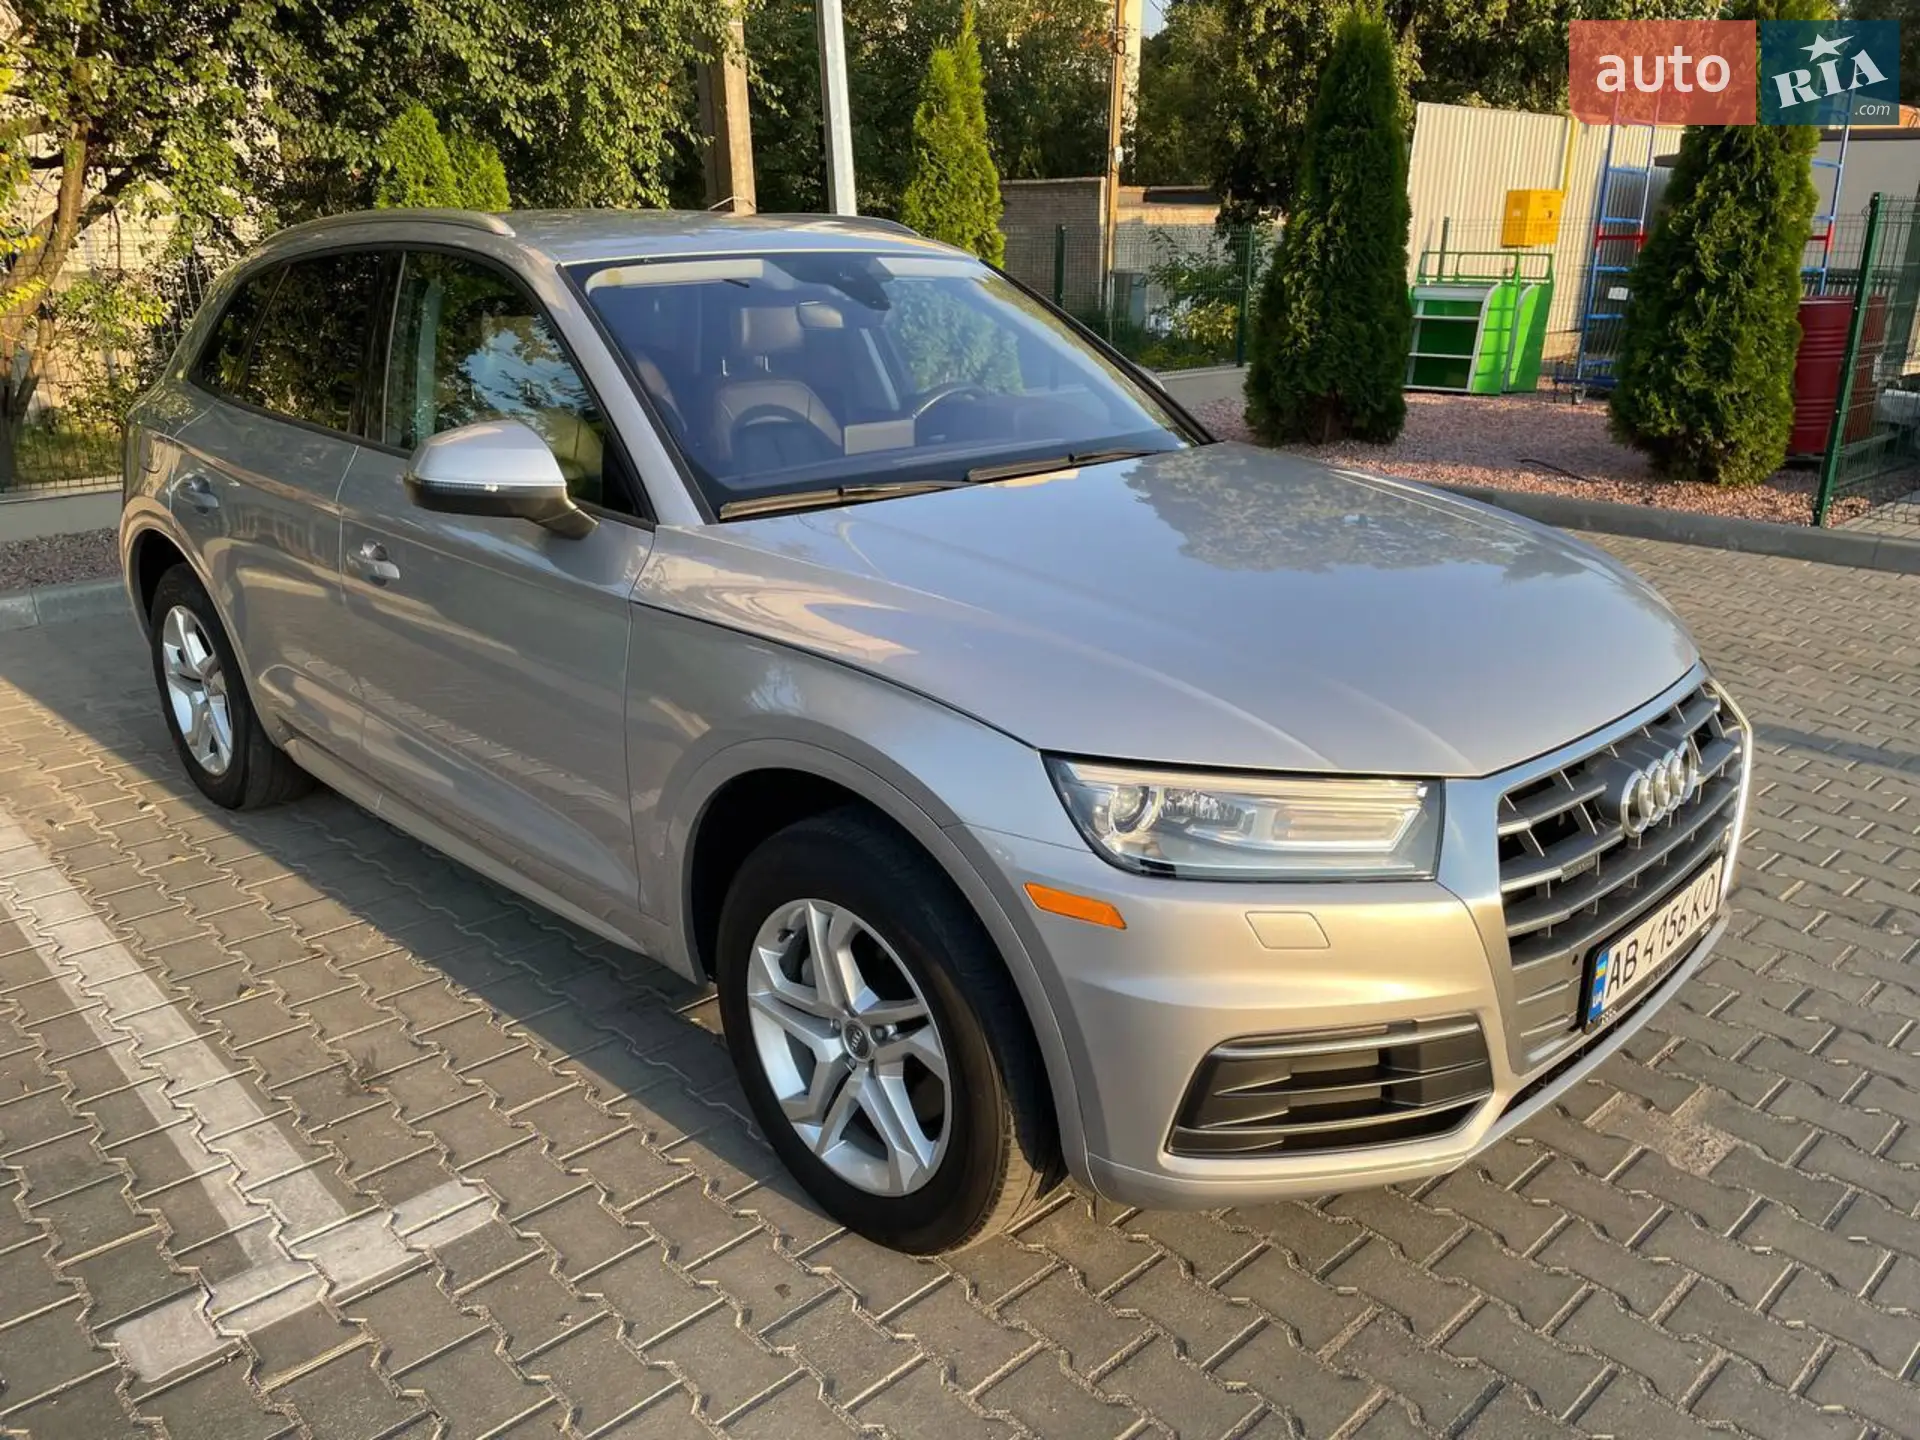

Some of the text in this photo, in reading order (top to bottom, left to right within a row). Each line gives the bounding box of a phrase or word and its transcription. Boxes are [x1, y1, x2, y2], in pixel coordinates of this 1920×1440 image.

[1606, 938, 1639, 999] AB
[1643, 894, 1689, 965] 4156
[1690, 873, 1716, 928] KO
